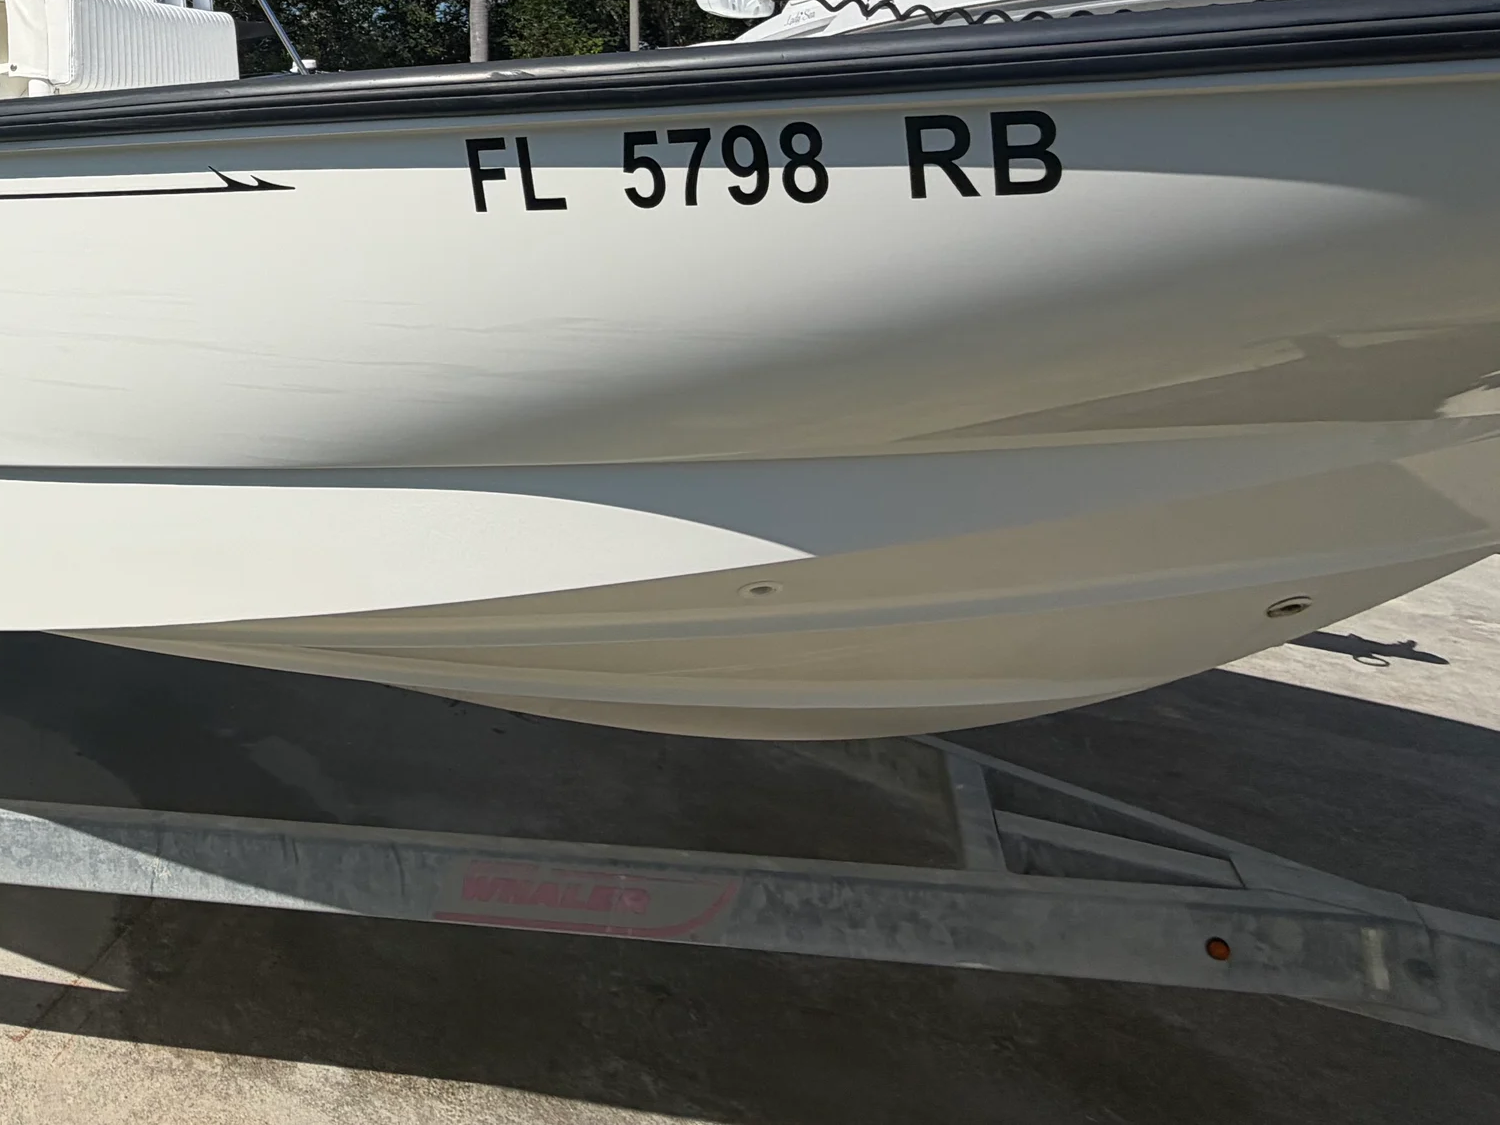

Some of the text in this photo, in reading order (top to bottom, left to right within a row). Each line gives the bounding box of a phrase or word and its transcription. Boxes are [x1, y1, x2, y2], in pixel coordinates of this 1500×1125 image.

[465, 110, 1063, 212] FL 5798 RB
[462, 874, 652, 916] WHALER
